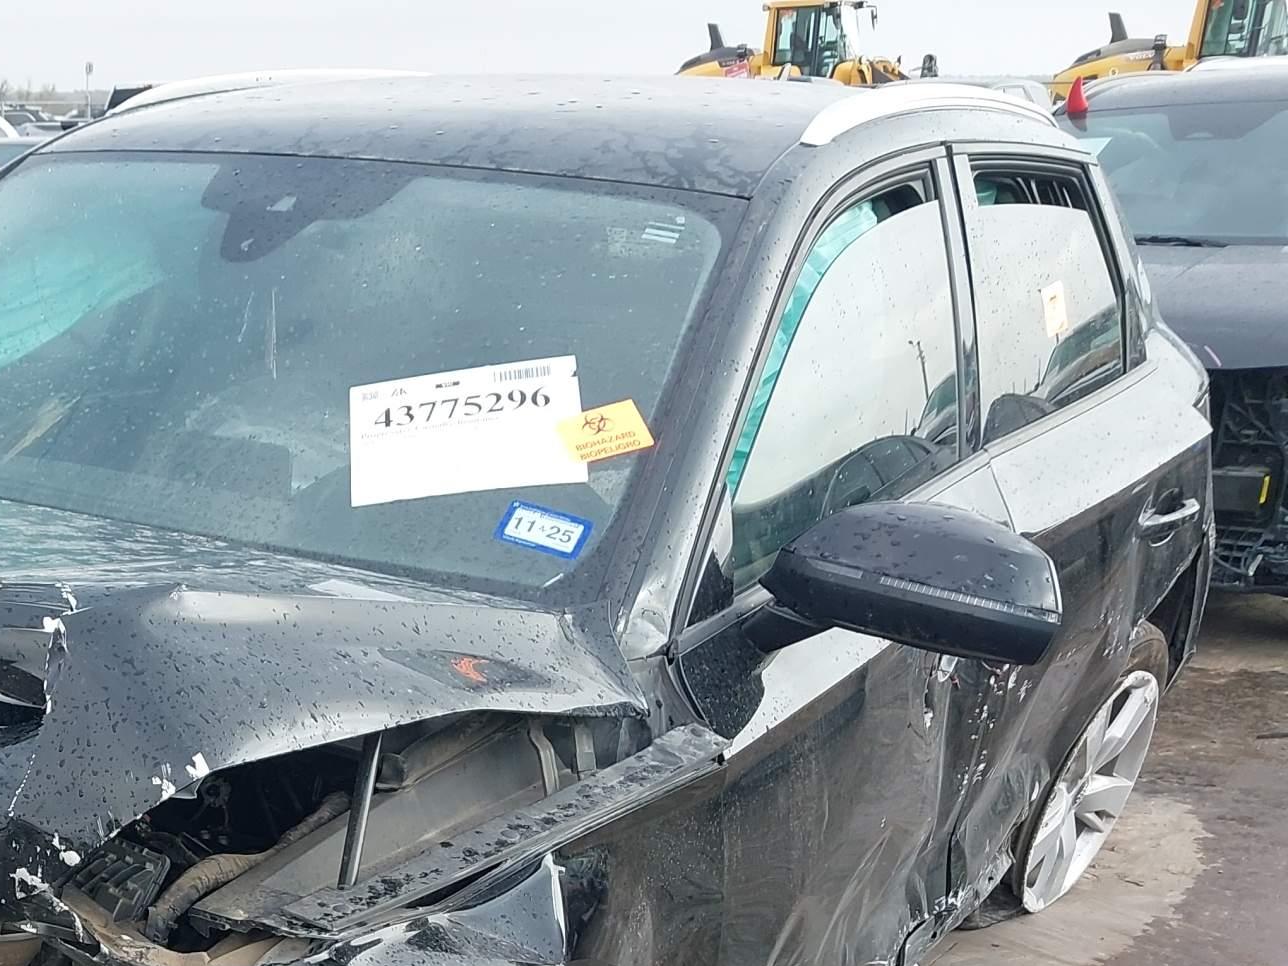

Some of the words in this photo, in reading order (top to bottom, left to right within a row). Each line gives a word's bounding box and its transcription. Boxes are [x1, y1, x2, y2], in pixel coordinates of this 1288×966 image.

[374, 386, 551, 428] 43775296
[575, 431, 636, 451] BIOHAZARD
[580, 439, 641, 461] BIOPELIGRO
